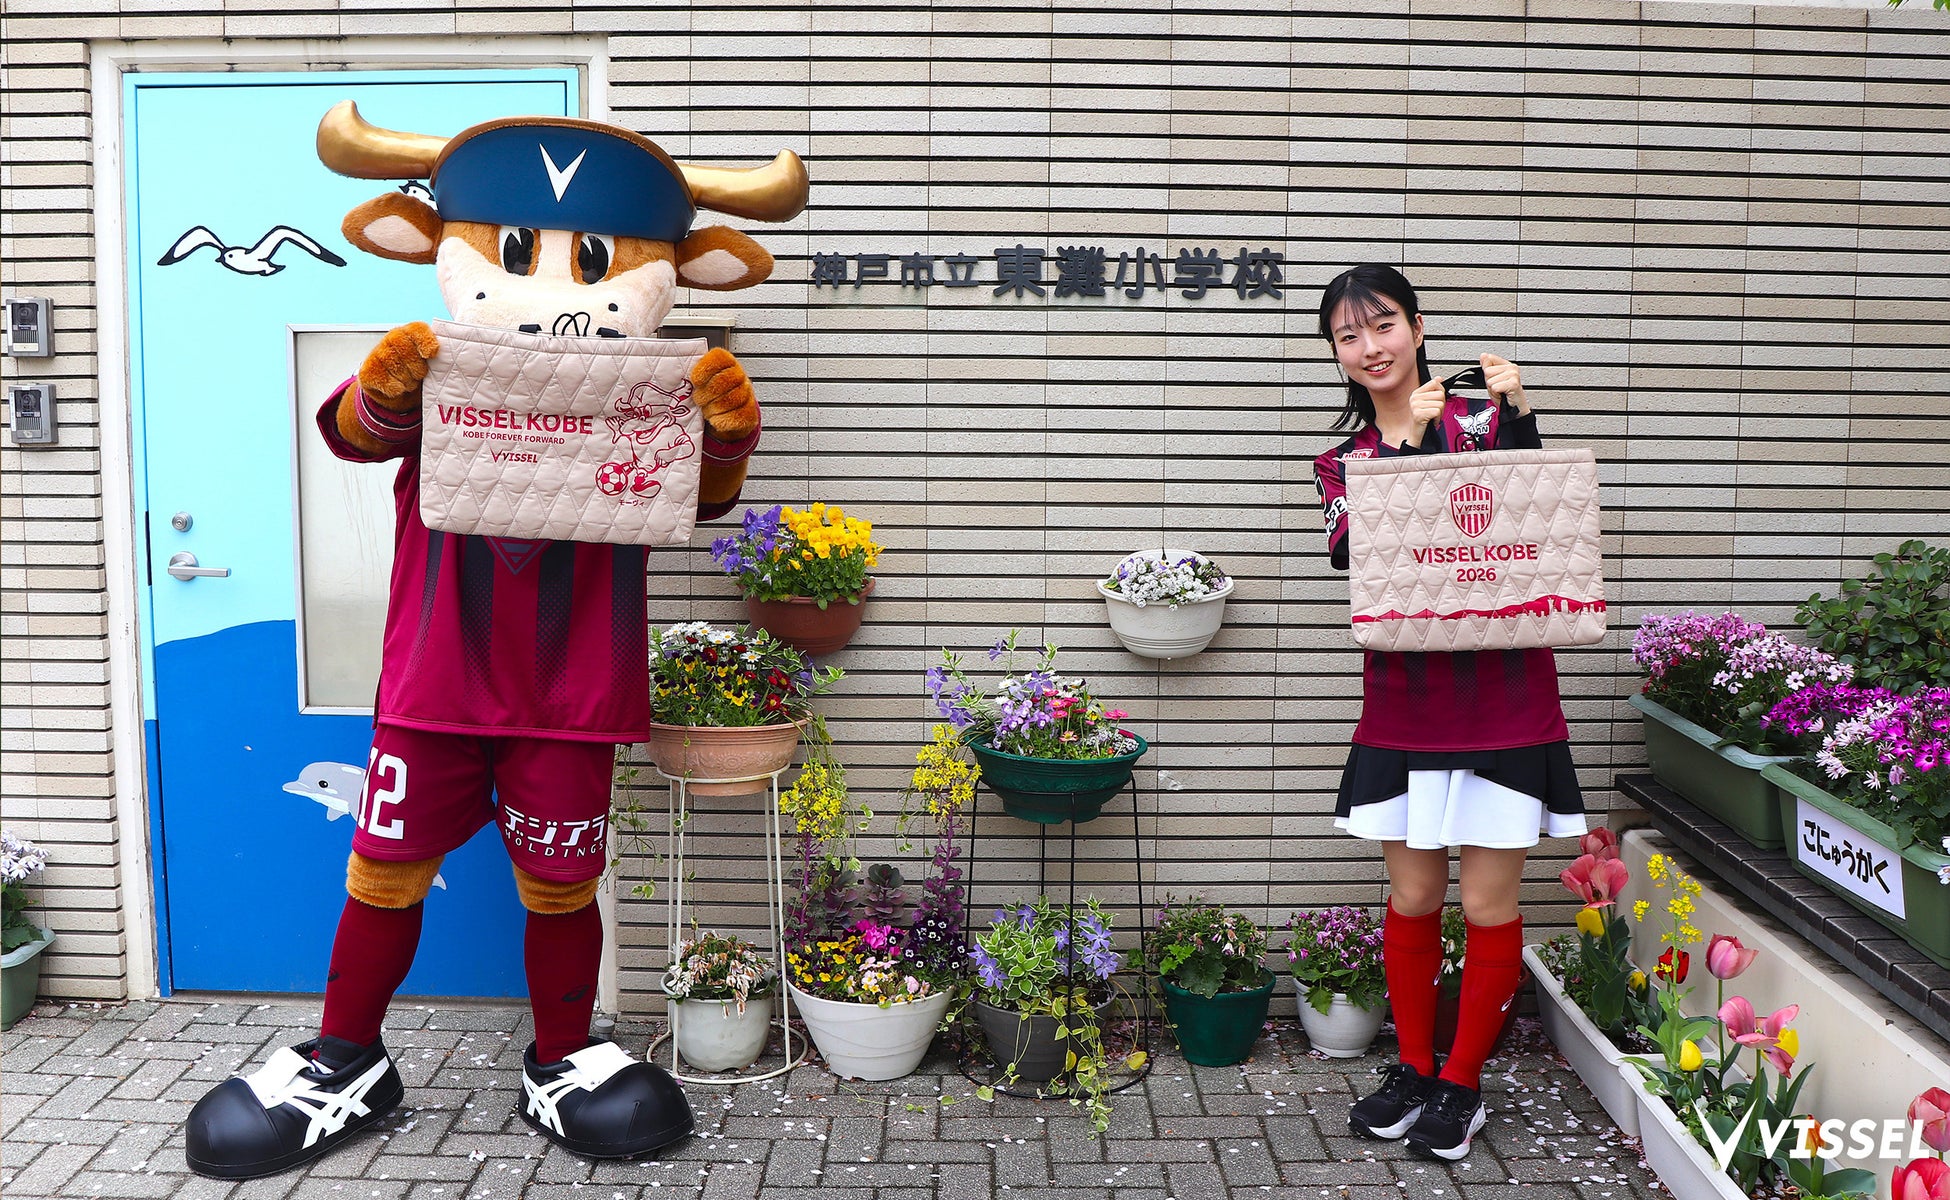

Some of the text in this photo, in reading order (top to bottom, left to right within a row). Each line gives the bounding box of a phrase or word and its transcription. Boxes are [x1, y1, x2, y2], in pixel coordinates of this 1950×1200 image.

[438, 404, 593, 434] VISSEL KOBE
[462, 430, 565, 445] KOBE FOREVER FORWARD
[502, 452, 538, 464] VISSEL
[1413, 544, 1538, 563] VISSEL KOBE
[1456, 568, 1497, 582] 2026
[505, 829, 605, 858] HOLDINGS
[1803, 820, 1891, 895] こにゅうがく
